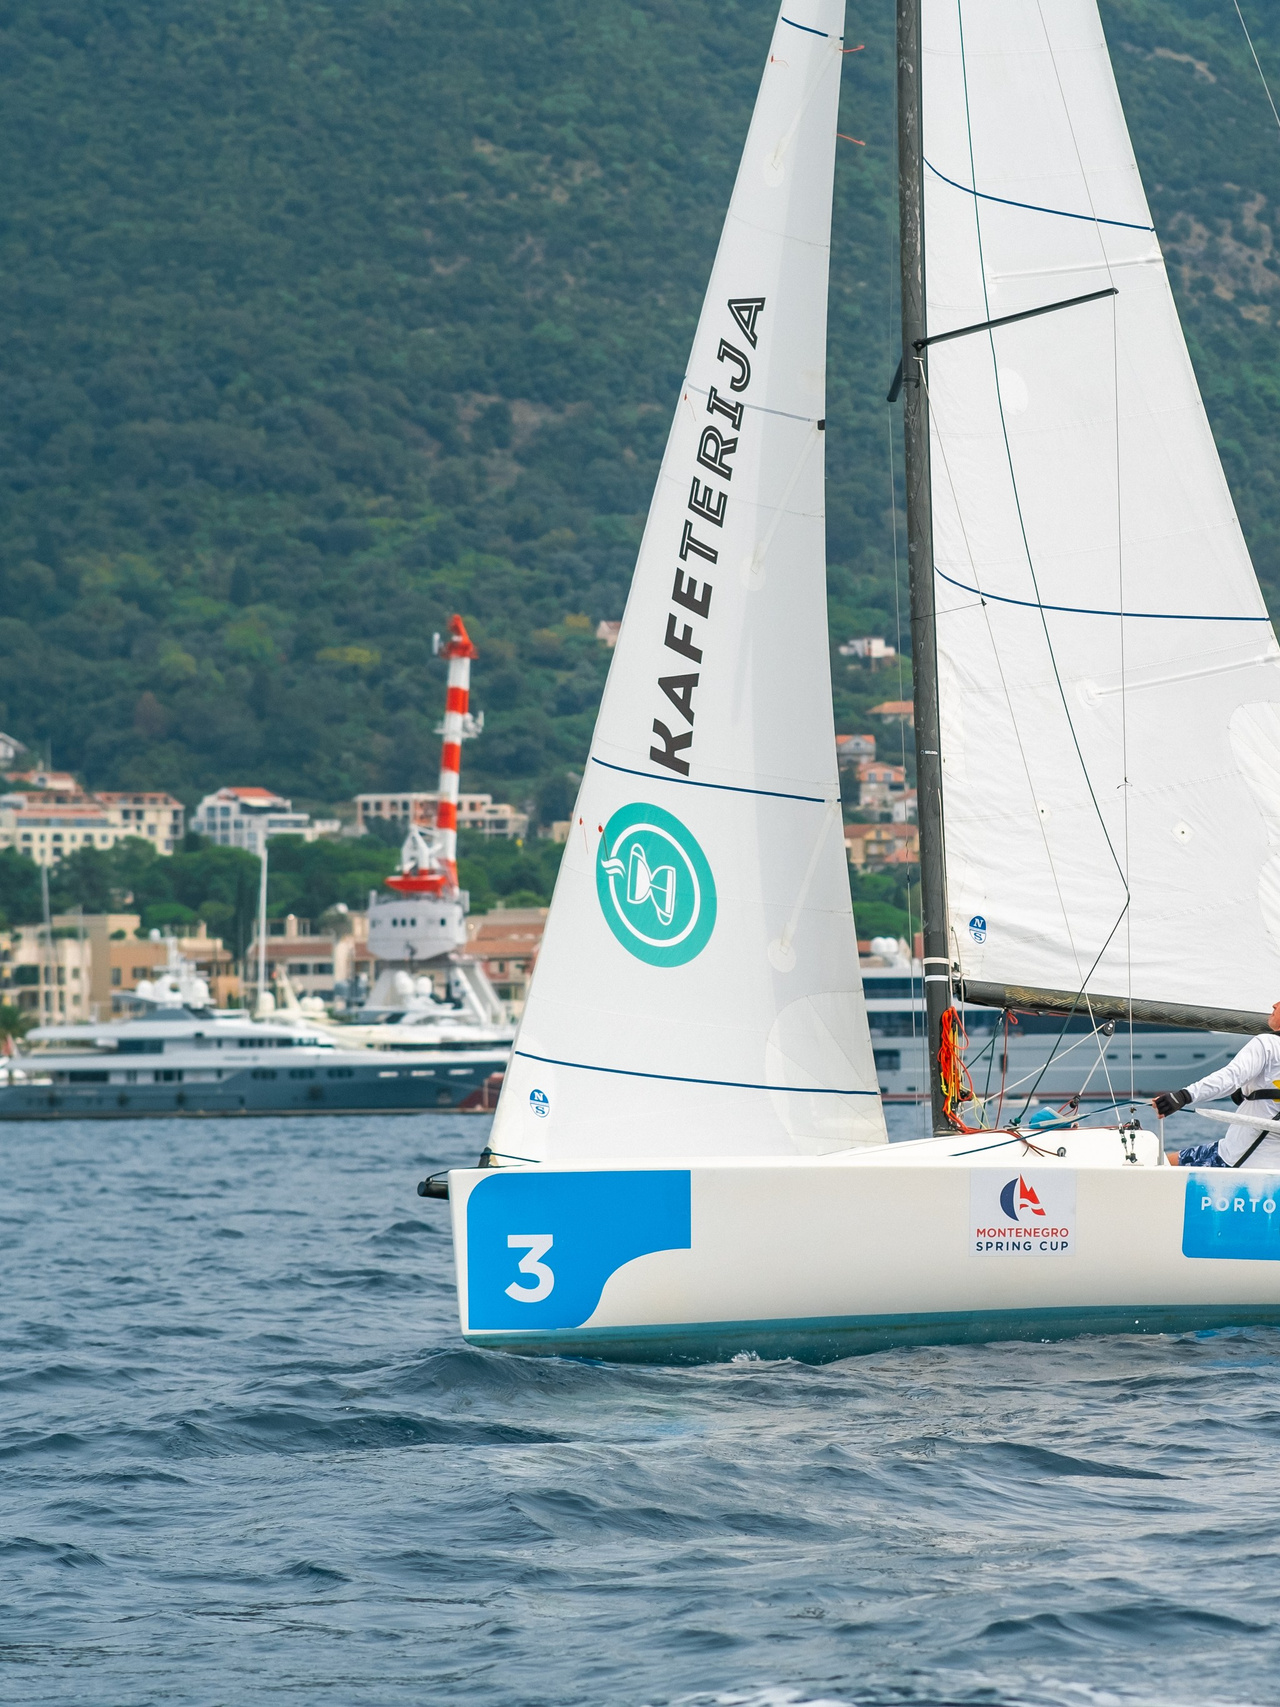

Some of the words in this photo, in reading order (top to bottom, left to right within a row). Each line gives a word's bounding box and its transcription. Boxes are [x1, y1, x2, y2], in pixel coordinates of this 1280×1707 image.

[648, 296, 767, 777] KAFETERIJA
[973, 918, 984, 928] N
[973, 932, 983, 941] S
[533, 1091, 544, 1102] N
[535, 1105, 546, 1115] S
[1201, 1196, 1277, 1214] PORTO
[976, 1227, 1070, 1238] MONTENEGRO
[976, 1240, 1033, 1251] SPRING
[1039, 1240, 1070, 1251] CUP
[504, 1233, 555, 1304] 3
